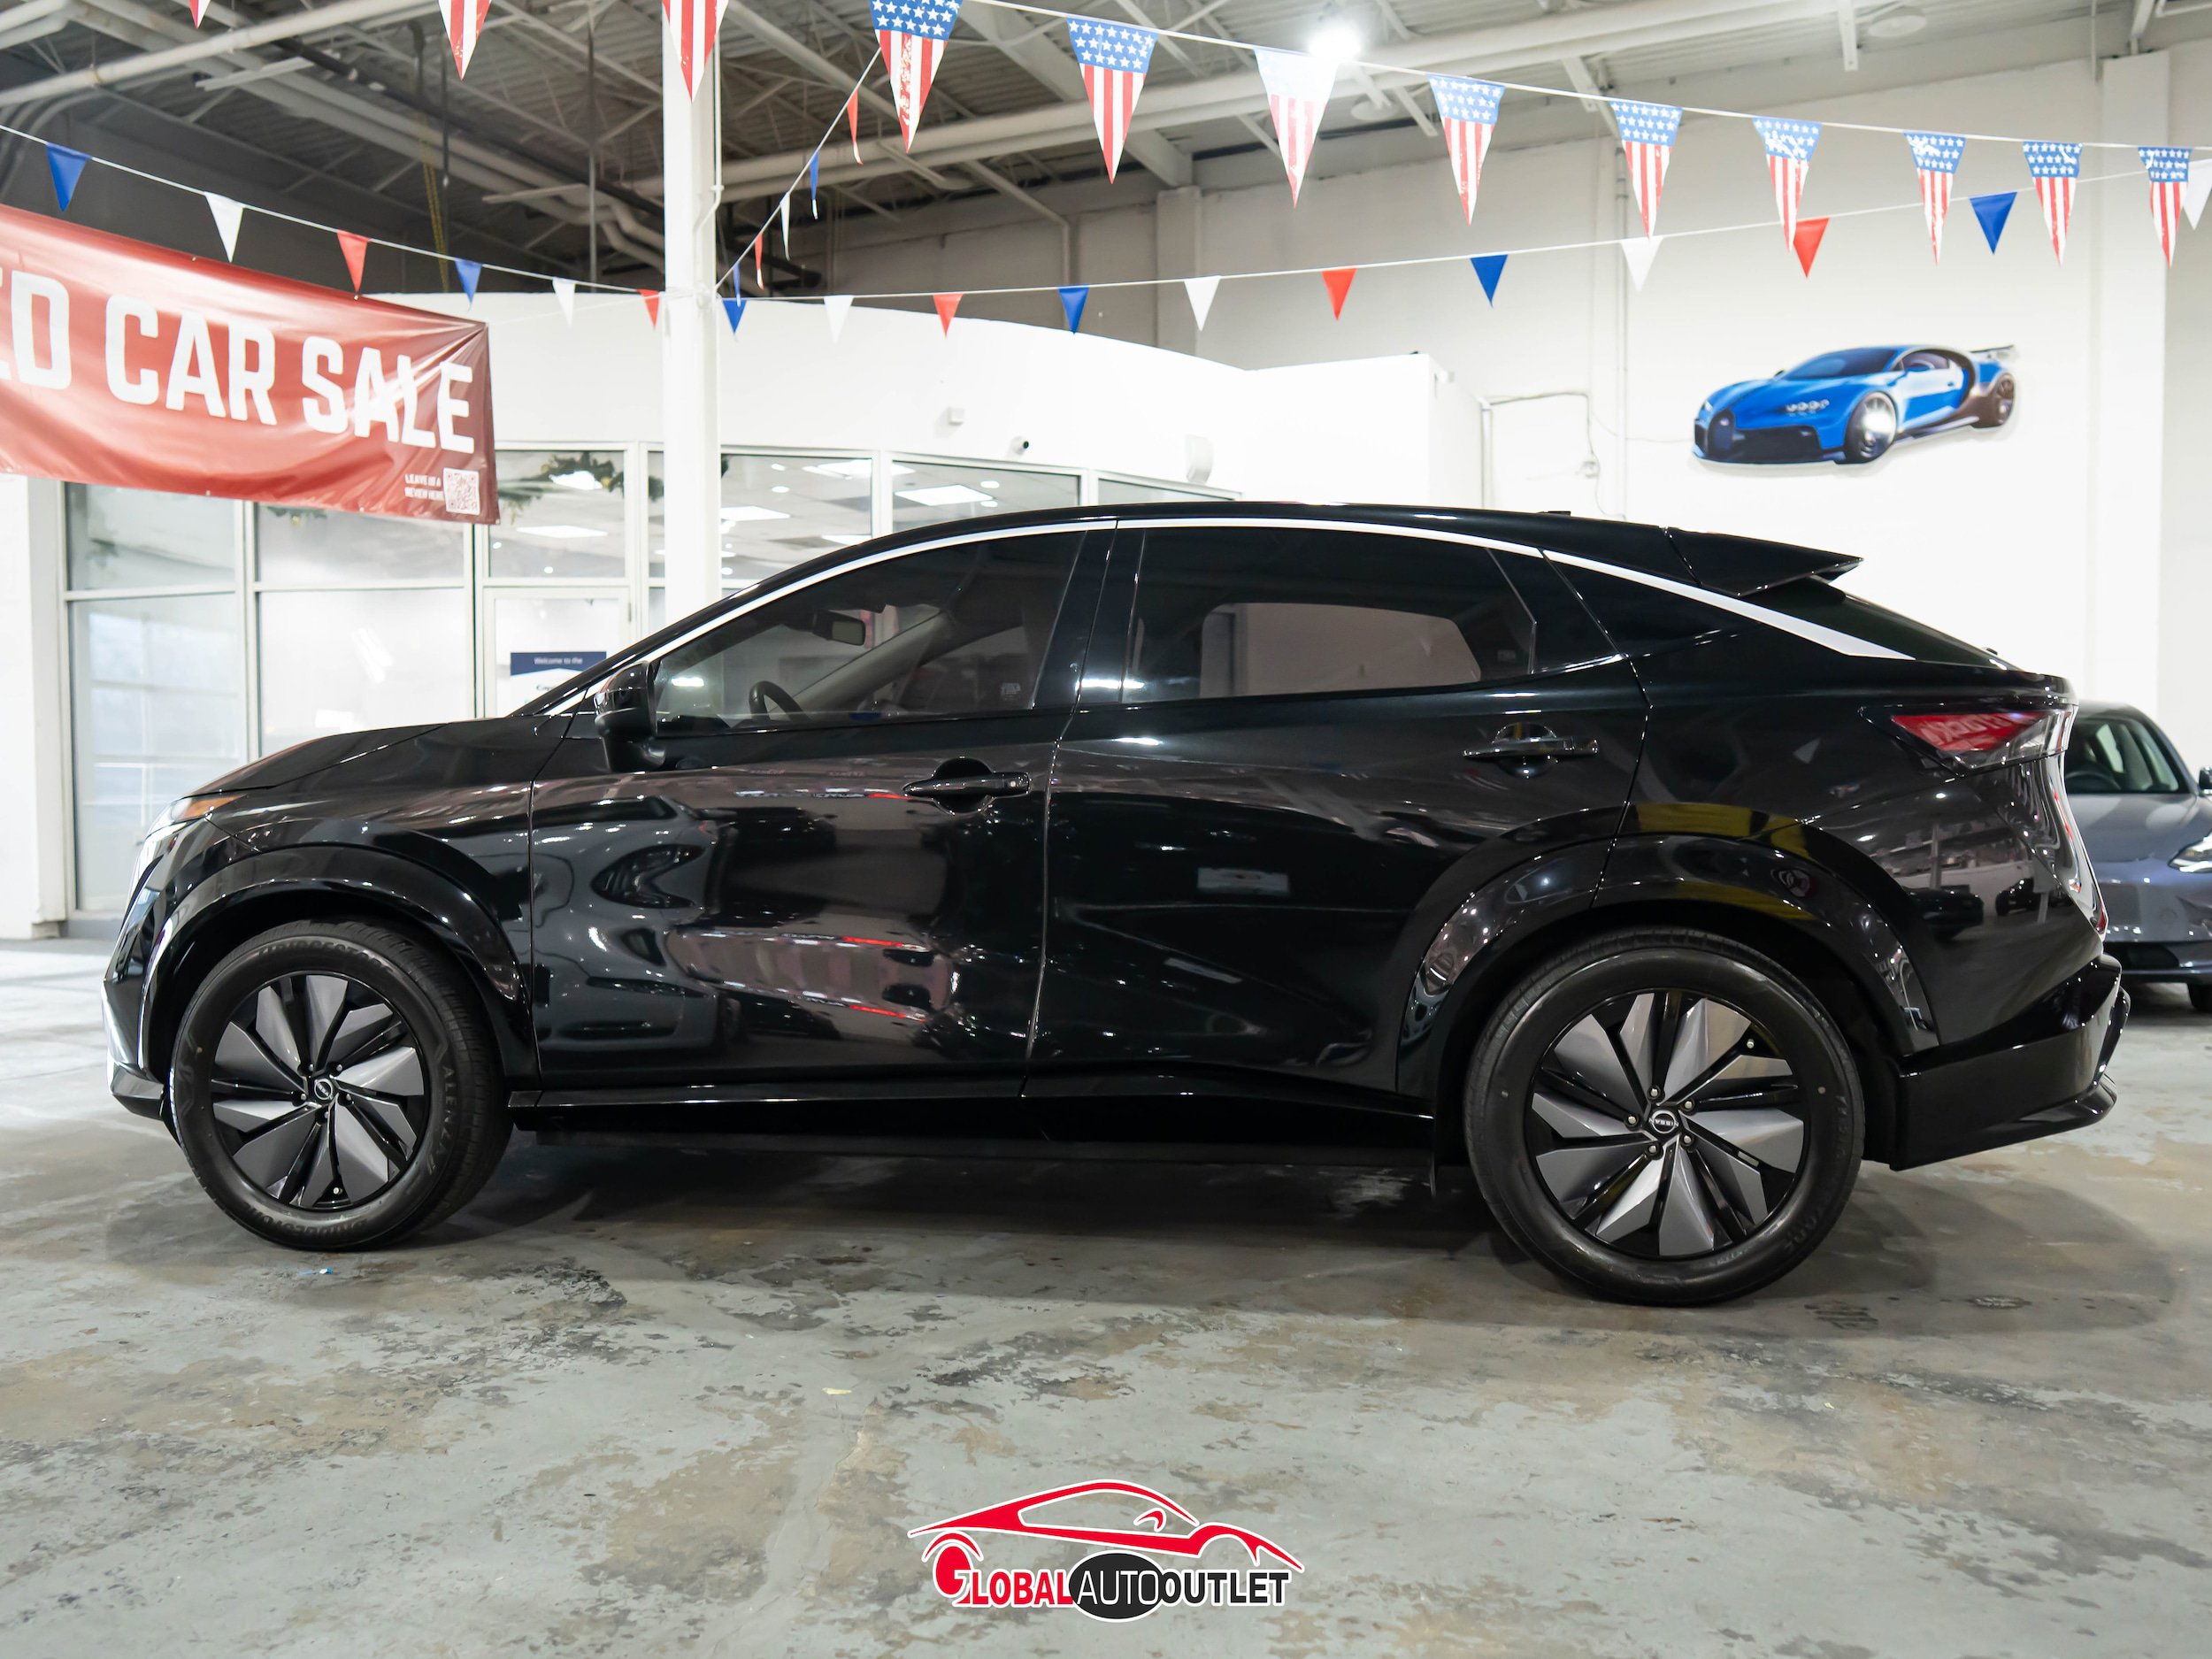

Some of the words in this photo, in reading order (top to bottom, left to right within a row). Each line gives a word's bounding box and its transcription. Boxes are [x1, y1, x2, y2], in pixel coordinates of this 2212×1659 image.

[0, 267, 72, 390] D
[104, 295, 277, 426] CAR
[302, 335, 474, 454] SALE
[404, 473, 427, 487] LEAVE
